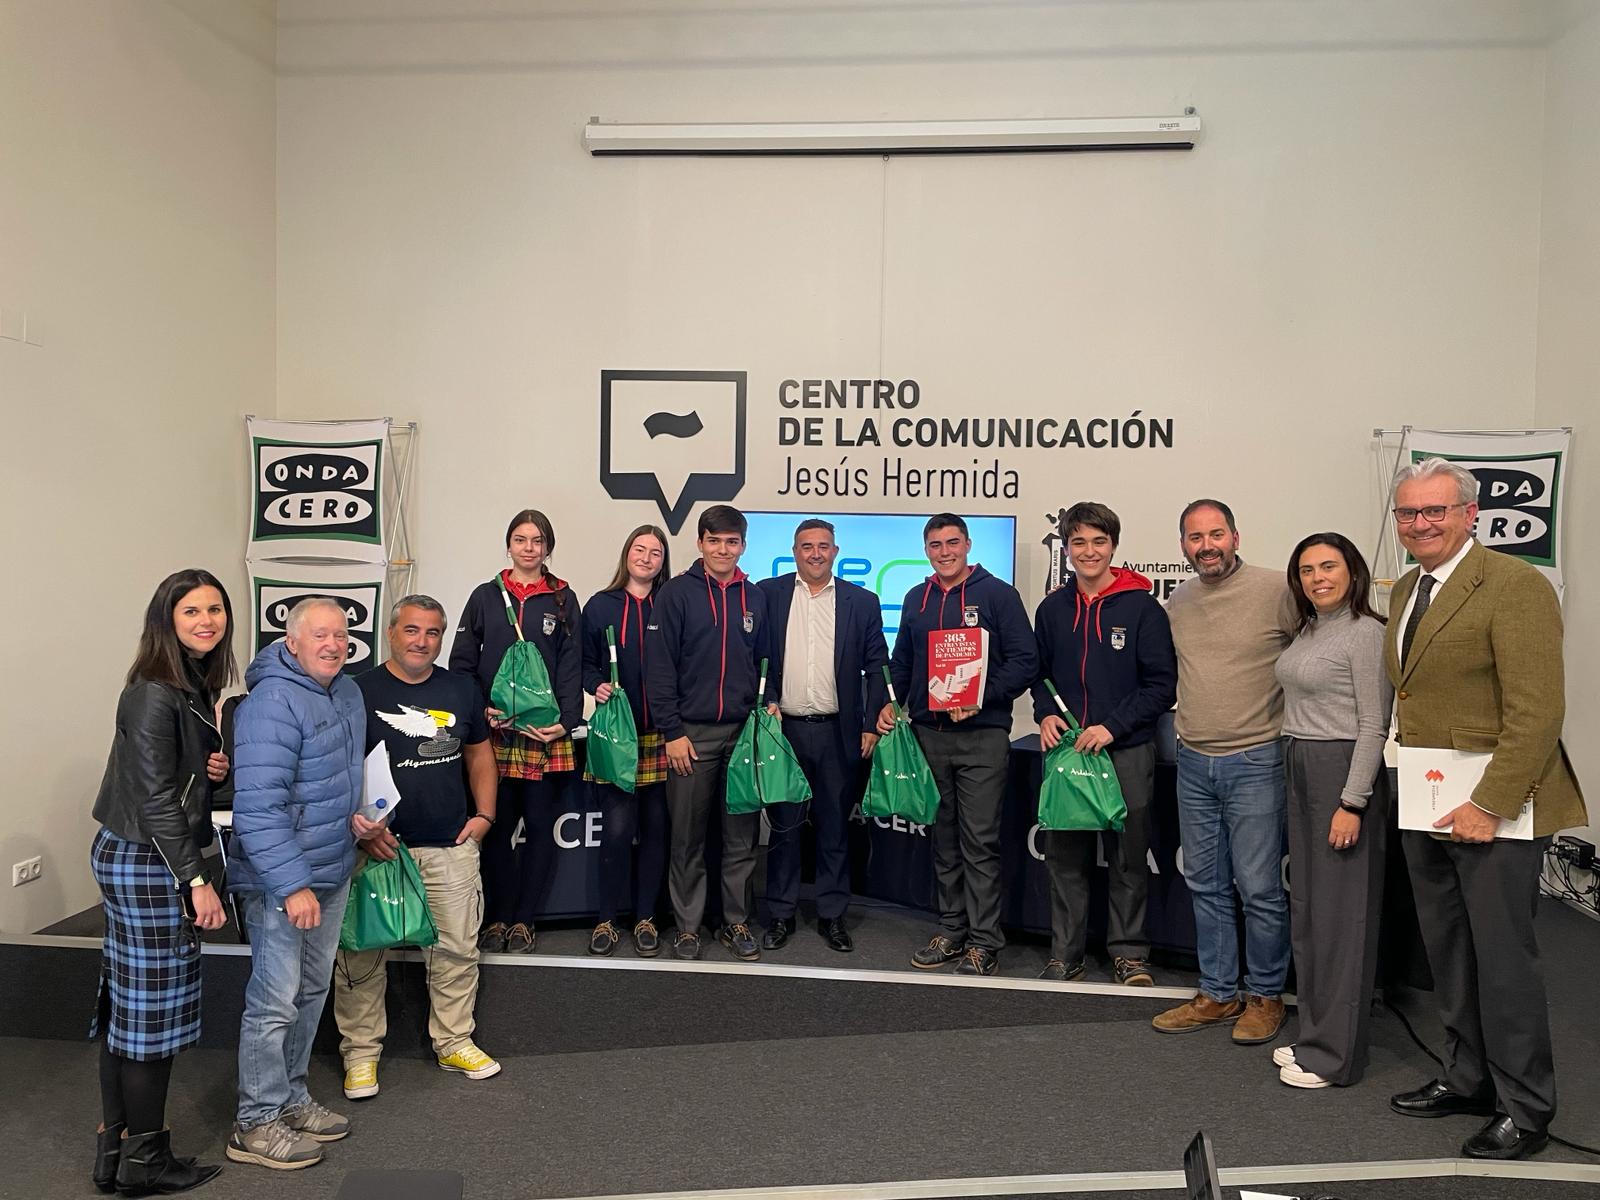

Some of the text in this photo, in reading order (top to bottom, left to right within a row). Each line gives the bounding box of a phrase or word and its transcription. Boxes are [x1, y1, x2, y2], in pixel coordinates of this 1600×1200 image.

[779, 379, 920, 409] CENTRO
[778, 410, 1174, 448] DE LA COMUNICACIÓN
[274, 463, 359, 481] ONDA
[777, 456, 1019, 498] Jesús Hermida
[278, 498, 359, 518] CERO
[1121, 560, 1194, 574] Ayuntamie
[275, 604, 358, 621] OA
[944, 633, 966, 642] 365
